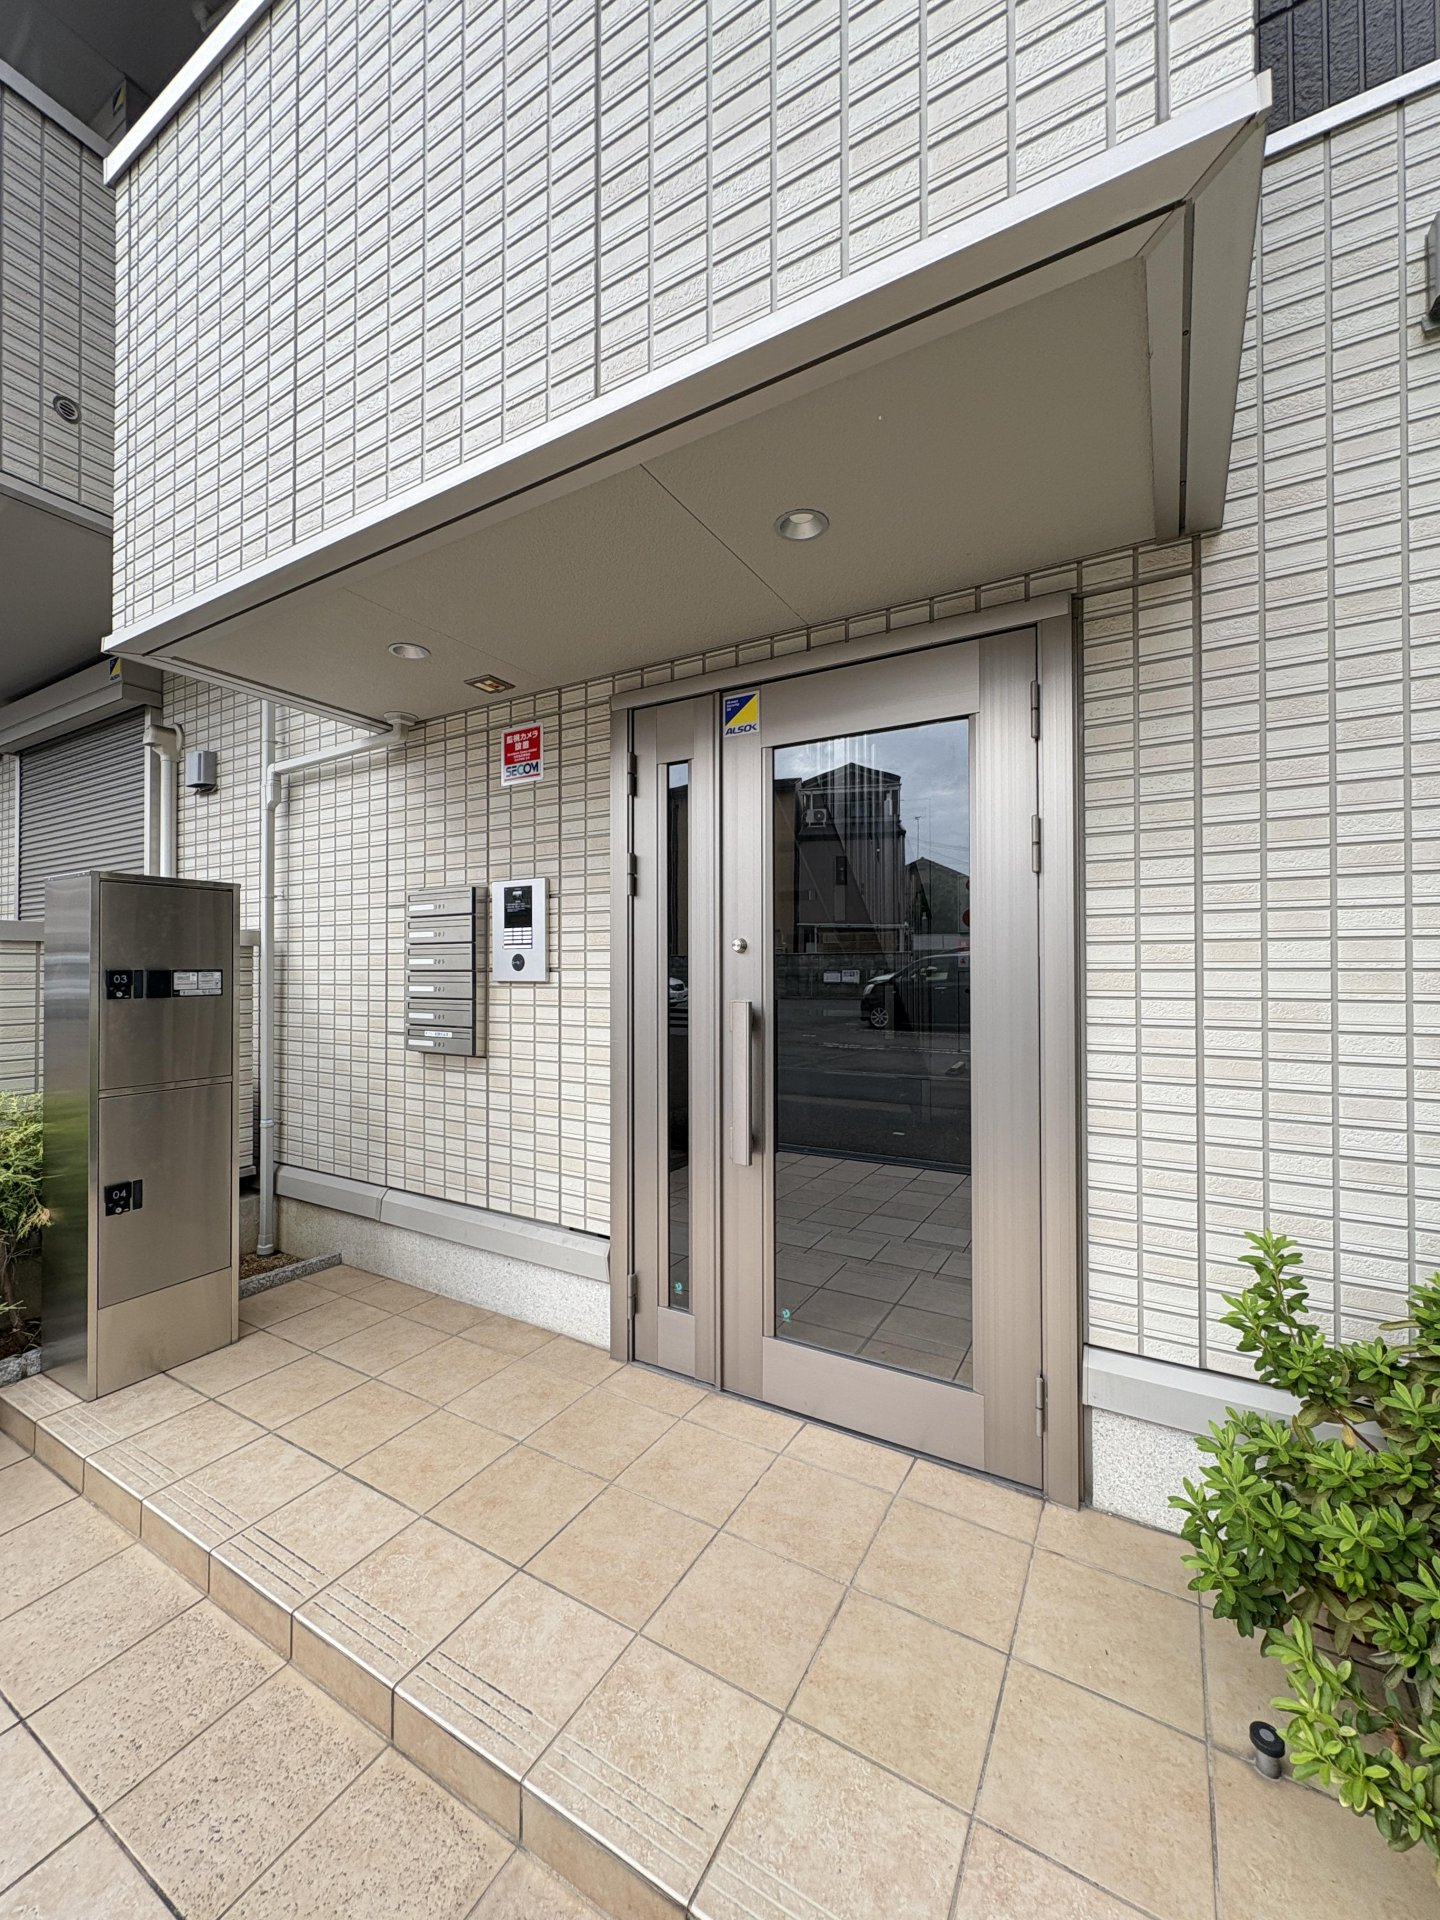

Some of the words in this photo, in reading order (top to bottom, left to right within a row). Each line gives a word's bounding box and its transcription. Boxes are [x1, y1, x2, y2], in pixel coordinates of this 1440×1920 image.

[725, 723, 757, 735] ALSOK
[505, 761, 539, 778] SECOM
[113, 974, 128, 984] 03
[112, 1189, 127, 1200] 04
